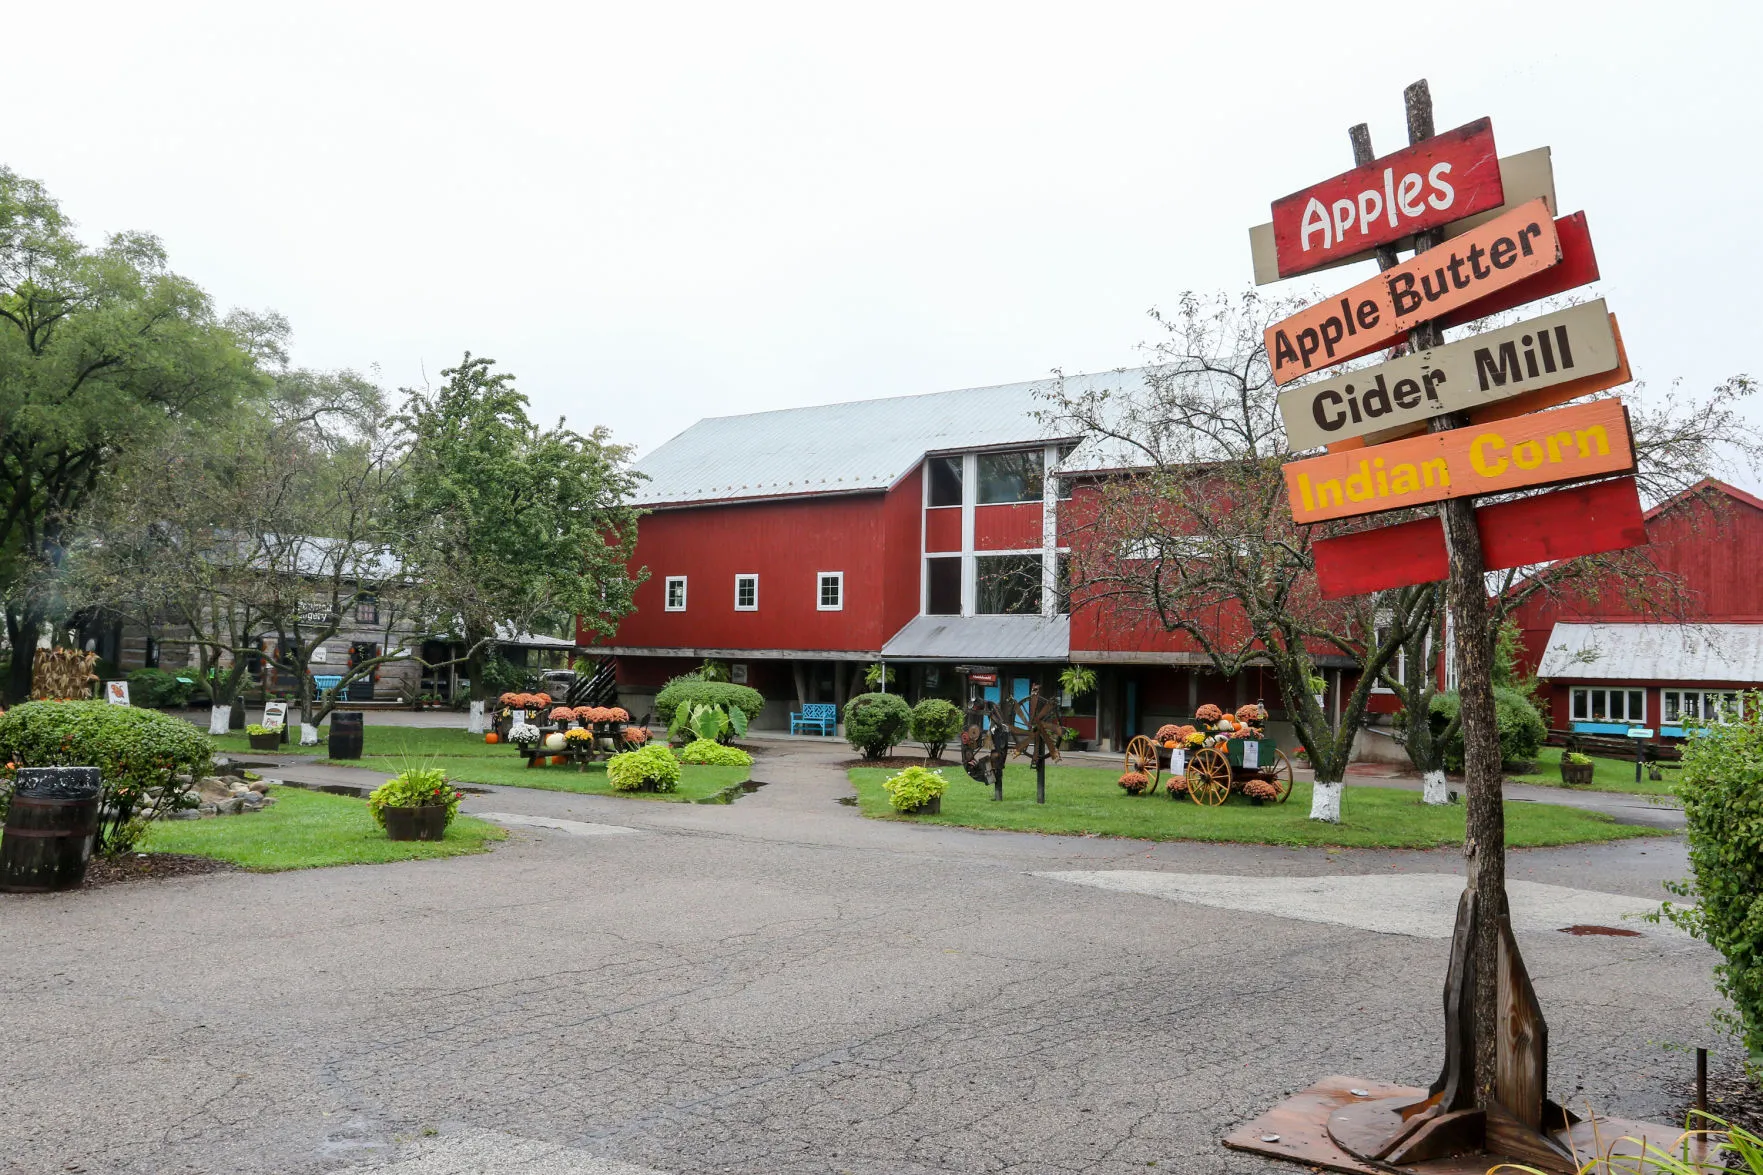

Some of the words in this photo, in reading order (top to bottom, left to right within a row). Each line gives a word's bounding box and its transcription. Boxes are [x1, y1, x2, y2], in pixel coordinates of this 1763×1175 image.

[1300, 162, 1455, 252] Apples
[1275, 298, 1380, 370] Apple
[1389, 223, 1542, 318] Butter
[1312, 367, 1446, 432] Cider
[1474, 325, 1575, 392] Mill
[1297, 457, 1450, 512] Indian
[1469, 424, 1610, 478] Corn
